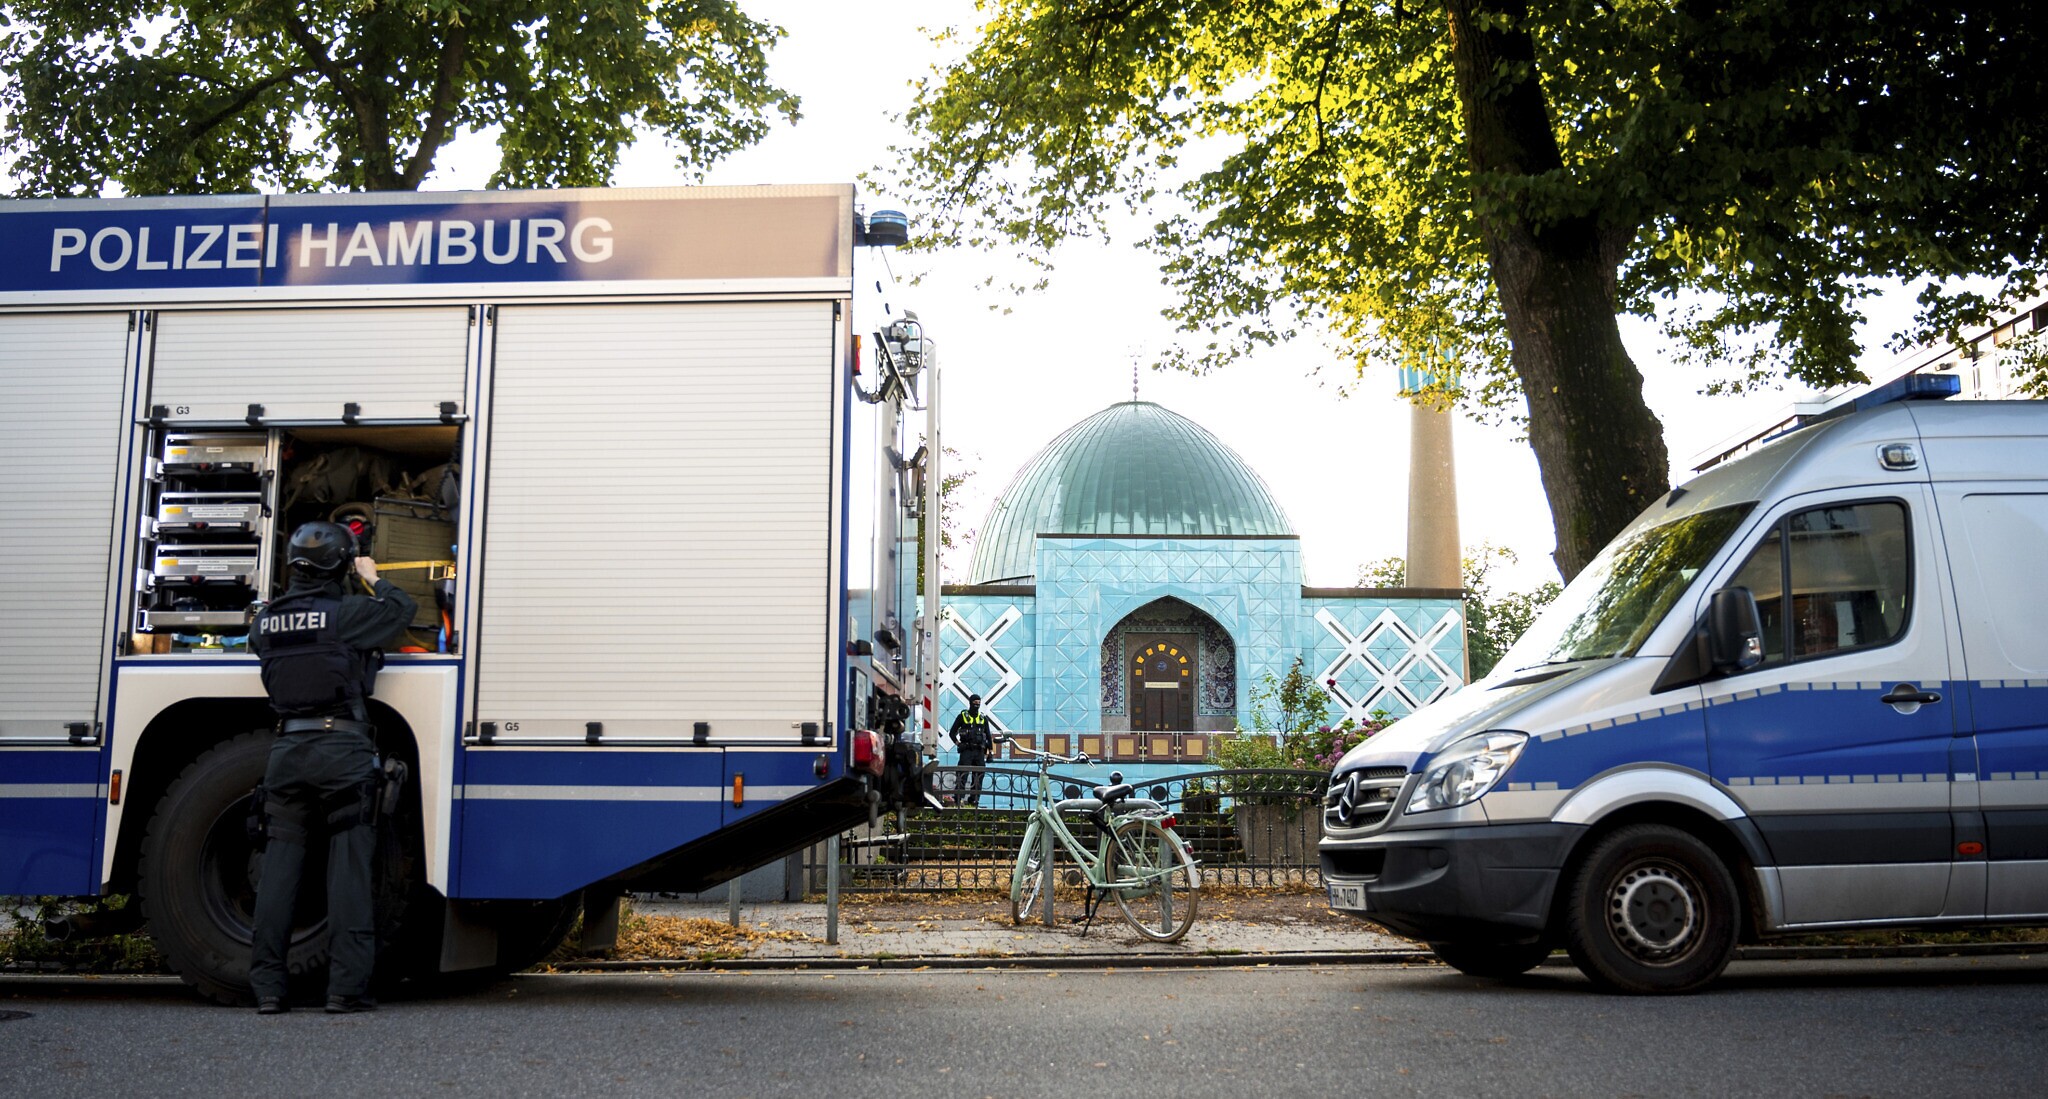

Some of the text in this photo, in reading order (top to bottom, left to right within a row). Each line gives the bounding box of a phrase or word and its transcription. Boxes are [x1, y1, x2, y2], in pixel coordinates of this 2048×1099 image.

[50, 217, 614, 272] POLIZEI HAMBURG
[176, 406, 190, 415] G3
[260, 611, 326, 635] POLIZEI
[505, 722, 520, 731] G5
